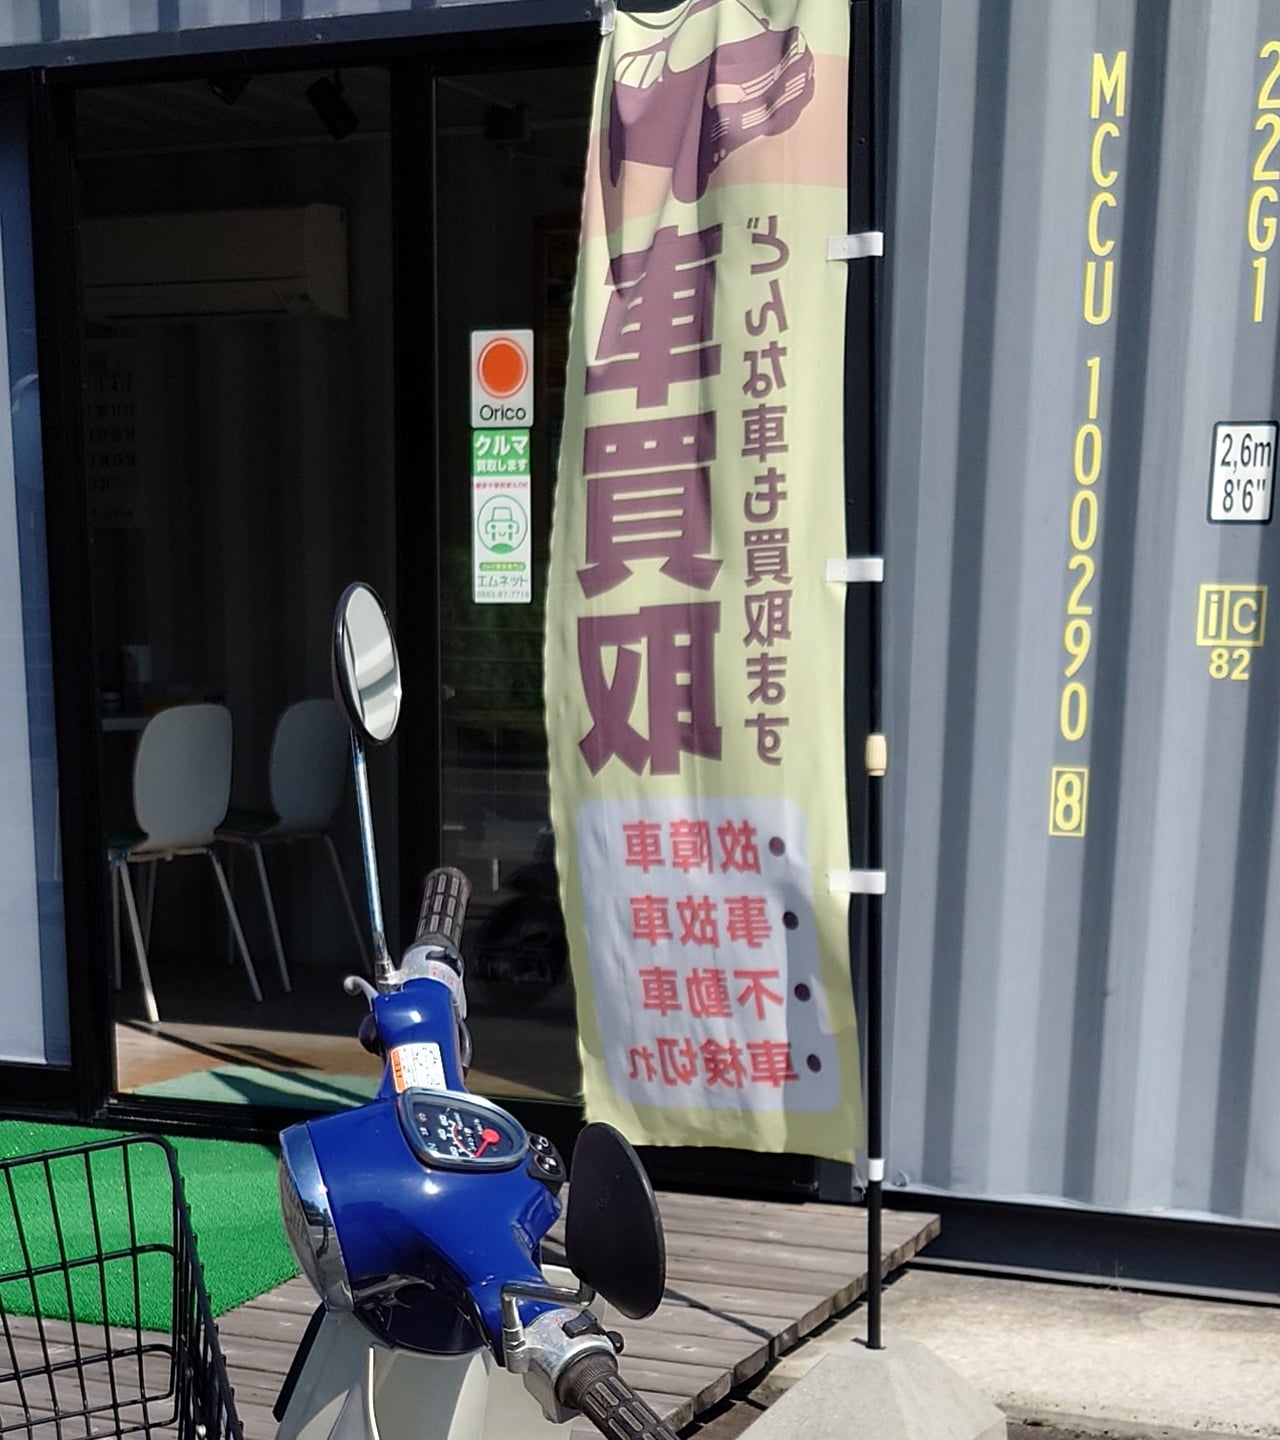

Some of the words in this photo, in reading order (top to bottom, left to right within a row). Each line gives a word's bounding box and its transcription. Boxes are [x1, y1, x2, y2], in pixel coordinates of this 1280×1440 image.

[1083, 50, 1128, 326] MCCU
[479, 403, 527, 421] Orico
[474, 434, 529, 457] クルマ
[1220, 432, 1272, 474] 2,6m
[1059, 355, 1103, 742] 100290
[476, 574, 529, 588] エムネット
[1208, 647, 1251, 681] 82
[1054, 772, 1083, 832] 8
